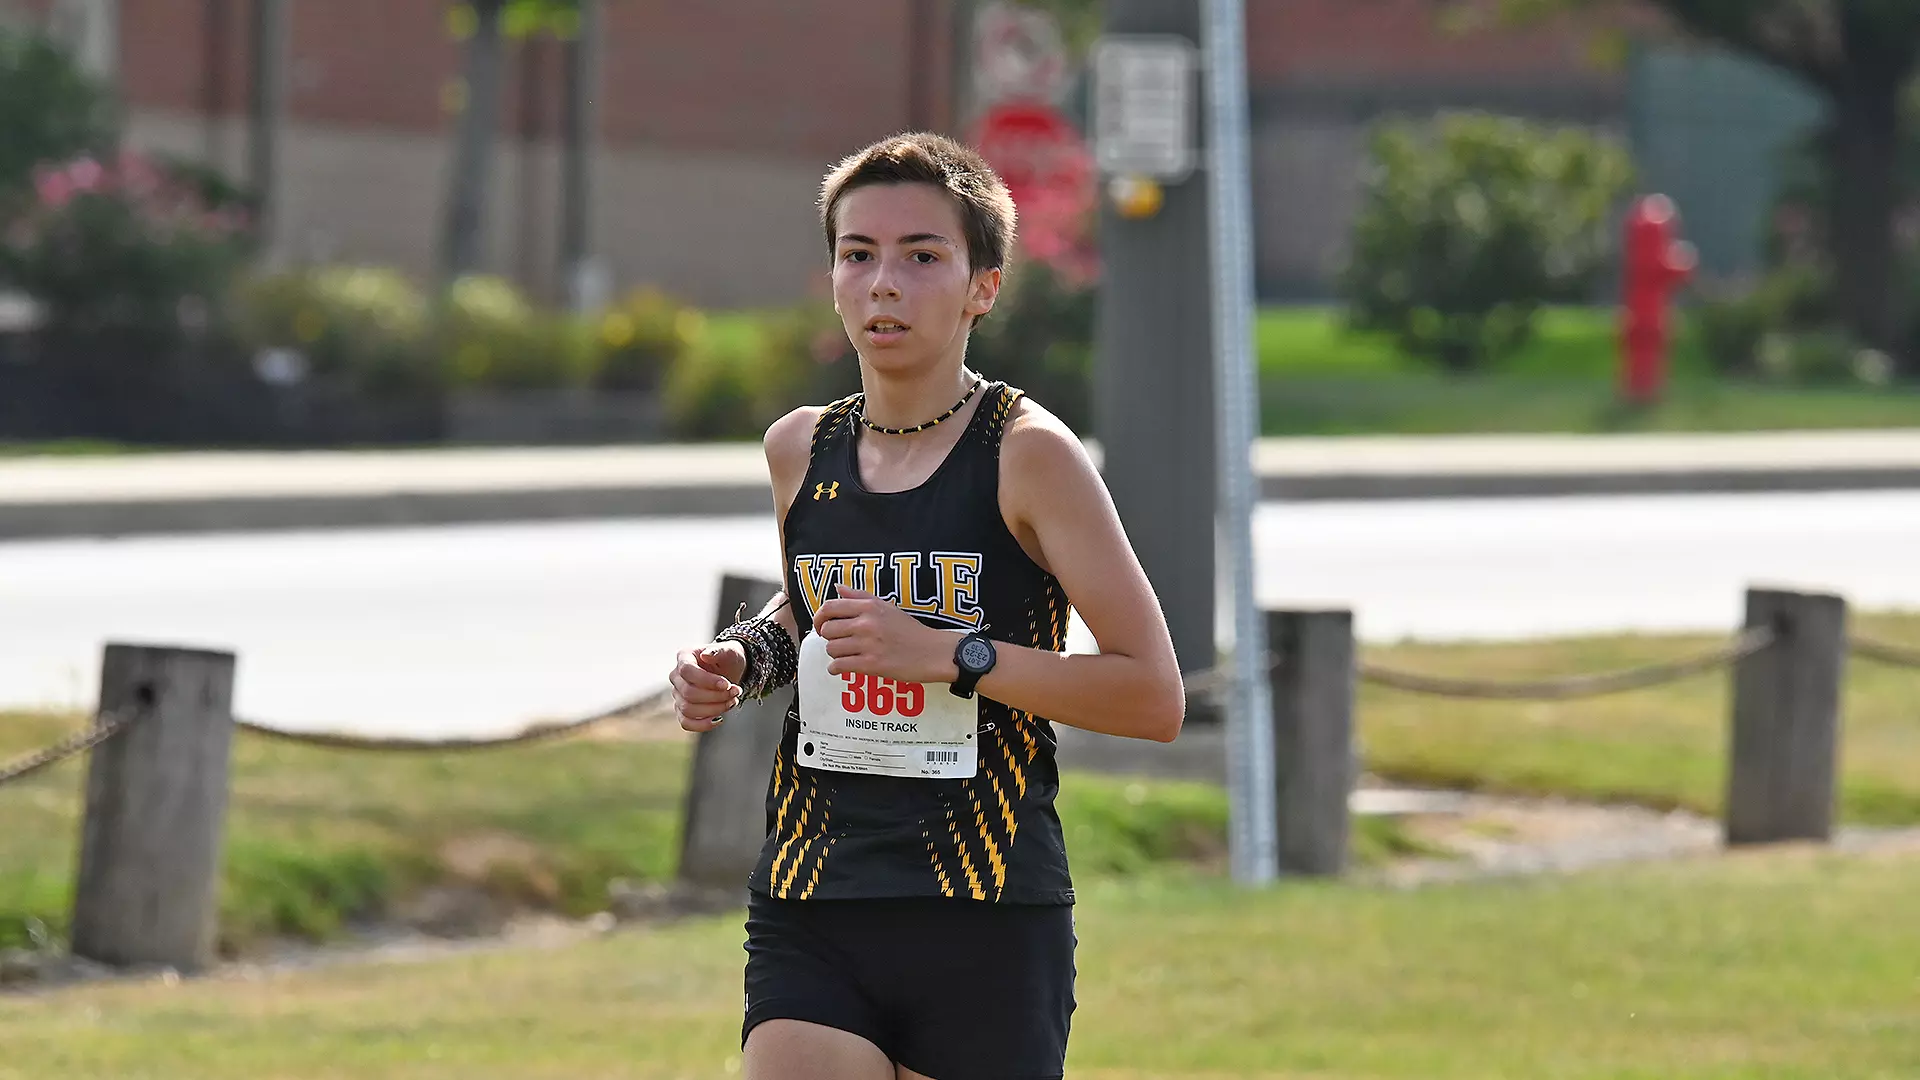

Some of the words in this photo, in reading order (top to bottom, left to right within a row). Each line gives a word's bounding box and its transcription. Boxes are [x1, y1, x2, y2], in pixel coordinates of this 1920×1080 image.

[794, 551, 983, 628] VILLE
[965, 648, 987, 661] 23:25
[840, 672, 925, 717] 365
[845, 718, 878, 731] INSIDE
[880, 722, 918, 733] TRACK
